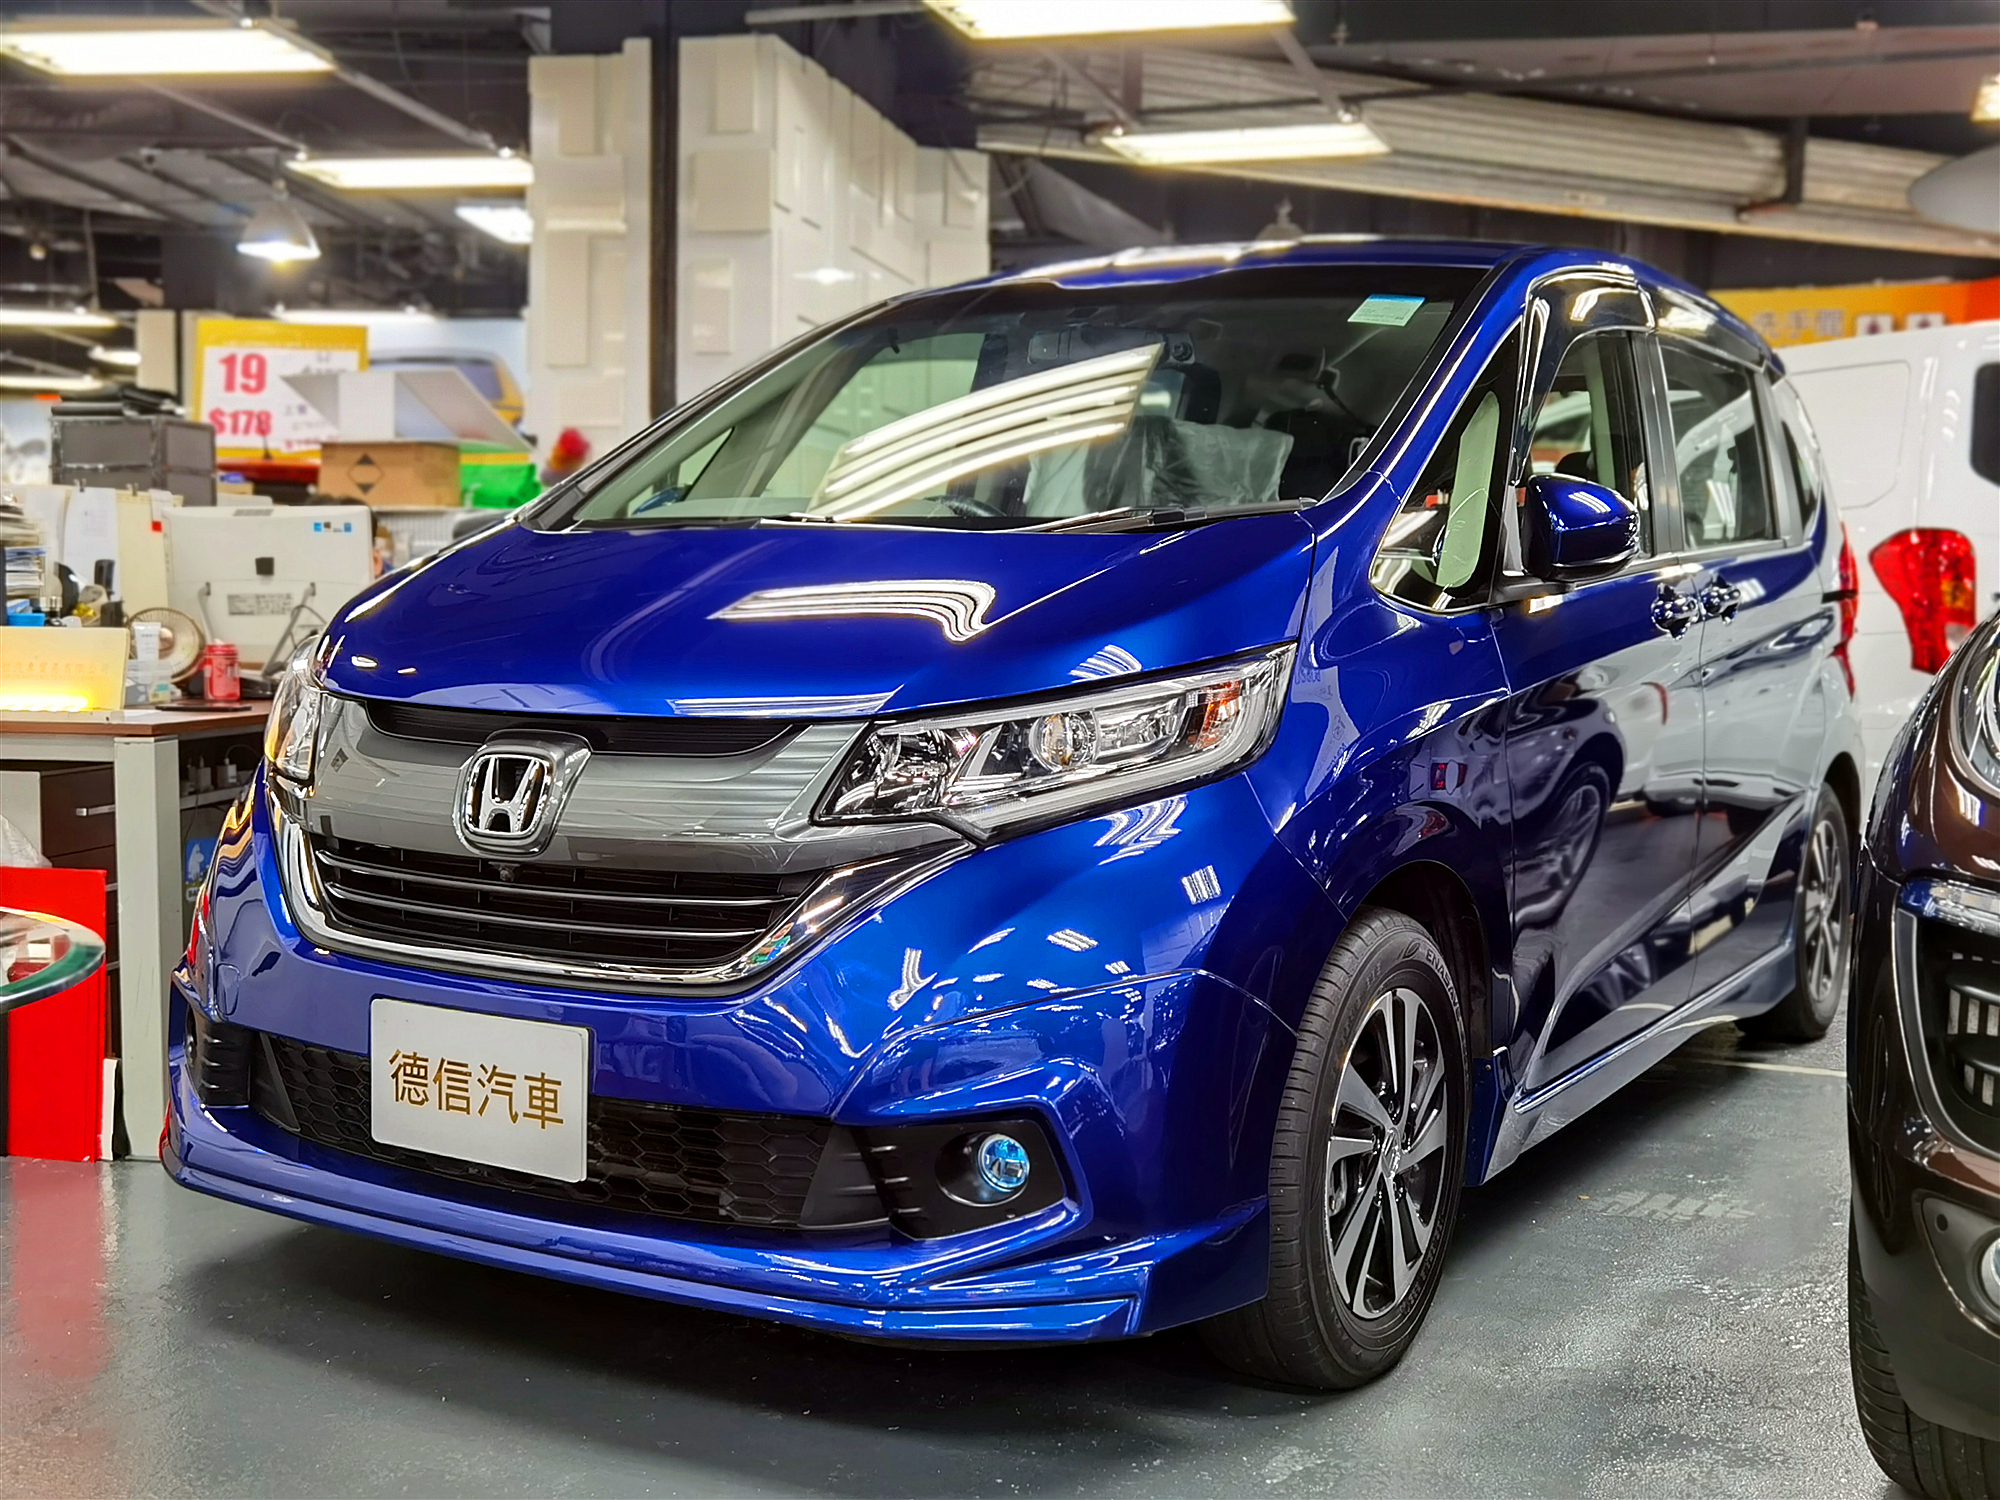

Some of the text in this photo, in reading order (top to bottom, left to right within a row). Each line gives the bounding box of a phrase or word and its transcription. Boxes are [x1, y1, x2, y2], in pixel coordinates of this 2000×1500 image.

[219, 352, 267, 395] 19
[209, 408, 272, 437] $178
[388, 1048, 564, 1130] 德信汽車
